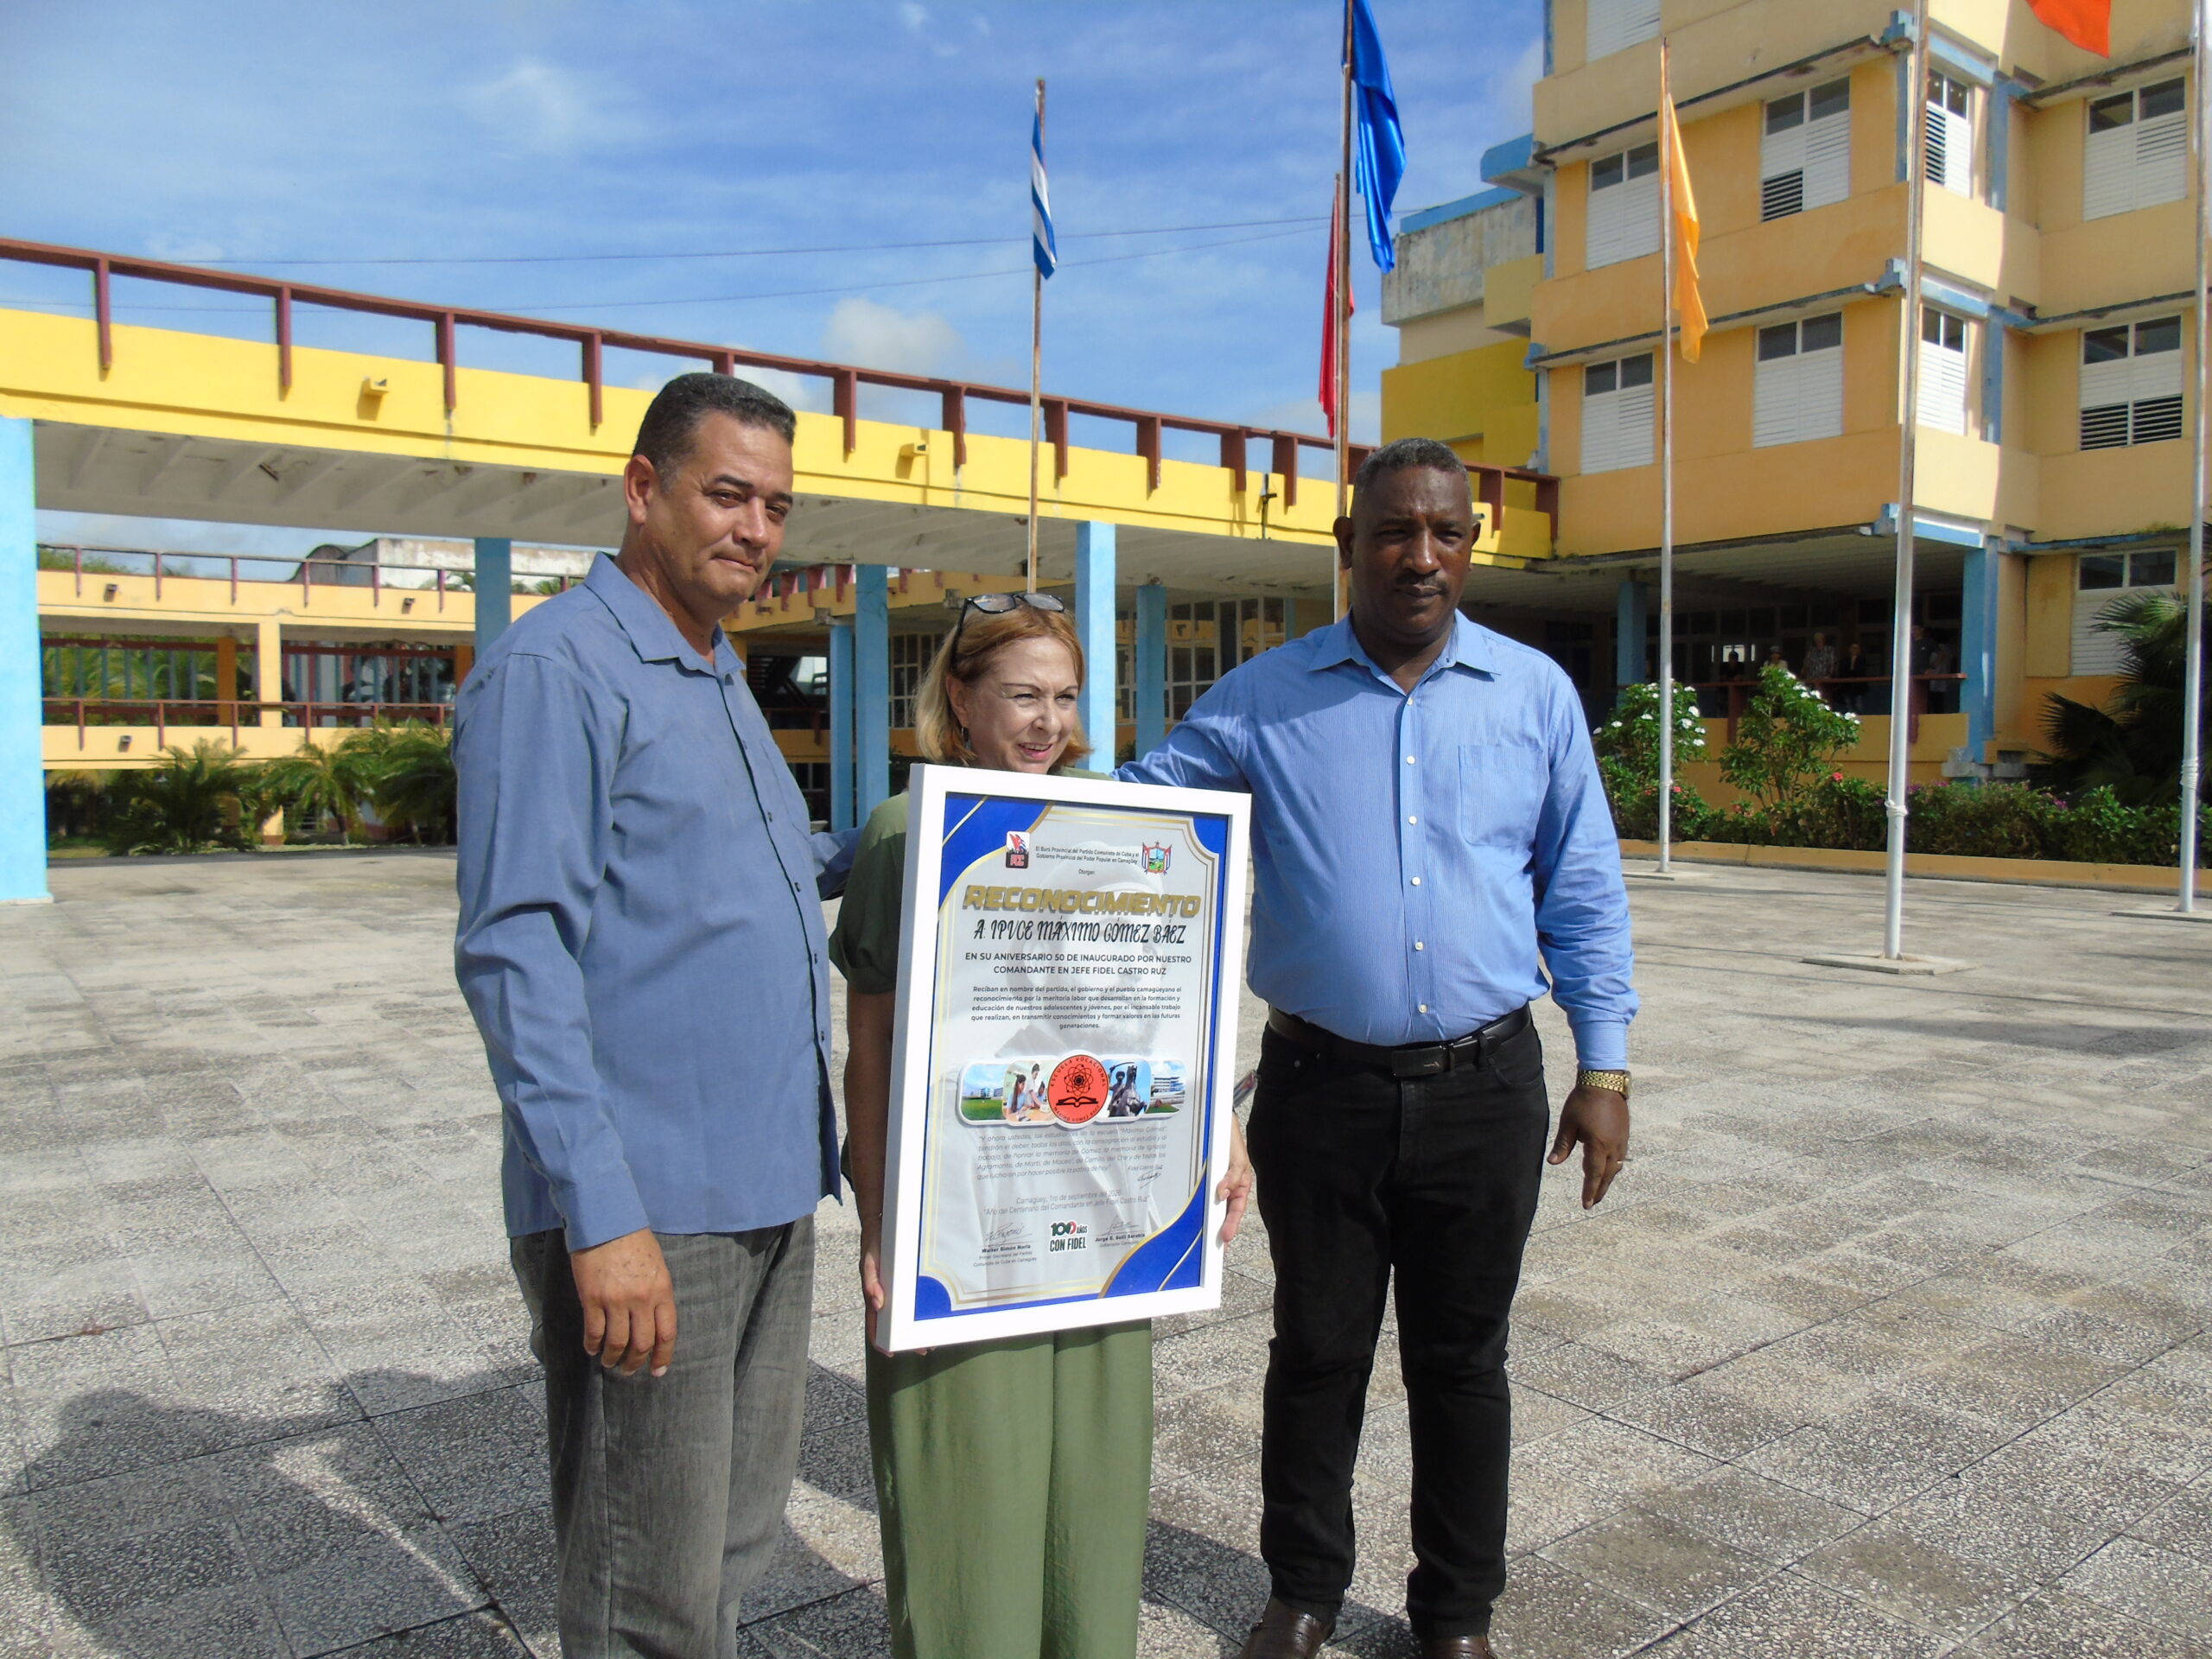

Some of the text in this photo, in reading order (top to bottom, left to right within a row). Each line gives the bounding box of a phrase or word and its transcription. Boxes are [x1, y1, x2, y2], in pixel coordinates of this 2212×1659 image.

[963, 885, 1201, 917] RECONOCIMIENTO
[1037, 915, 1100, 942] MÁXIMO
[1103, 917, 1151, 943] GÓMEZ
[1153, 918, 1187, 944] BÁEZ
[979, 952, 992, 961] SU
[1080, 954, 1135, 963] INAUGURADO
[994, 965, 1055, 974] COMANDANTE
[1092, 966, 1115, 975] FIDEL
[1050, 1057, 1106, 1087] ESCUELA VOCACIONAL
[1051, 1221, 1077, 1236] 100
[1050, 1239, 1065, 1252] CON
[1067, 1236, 1086, 1250] FIDEL
